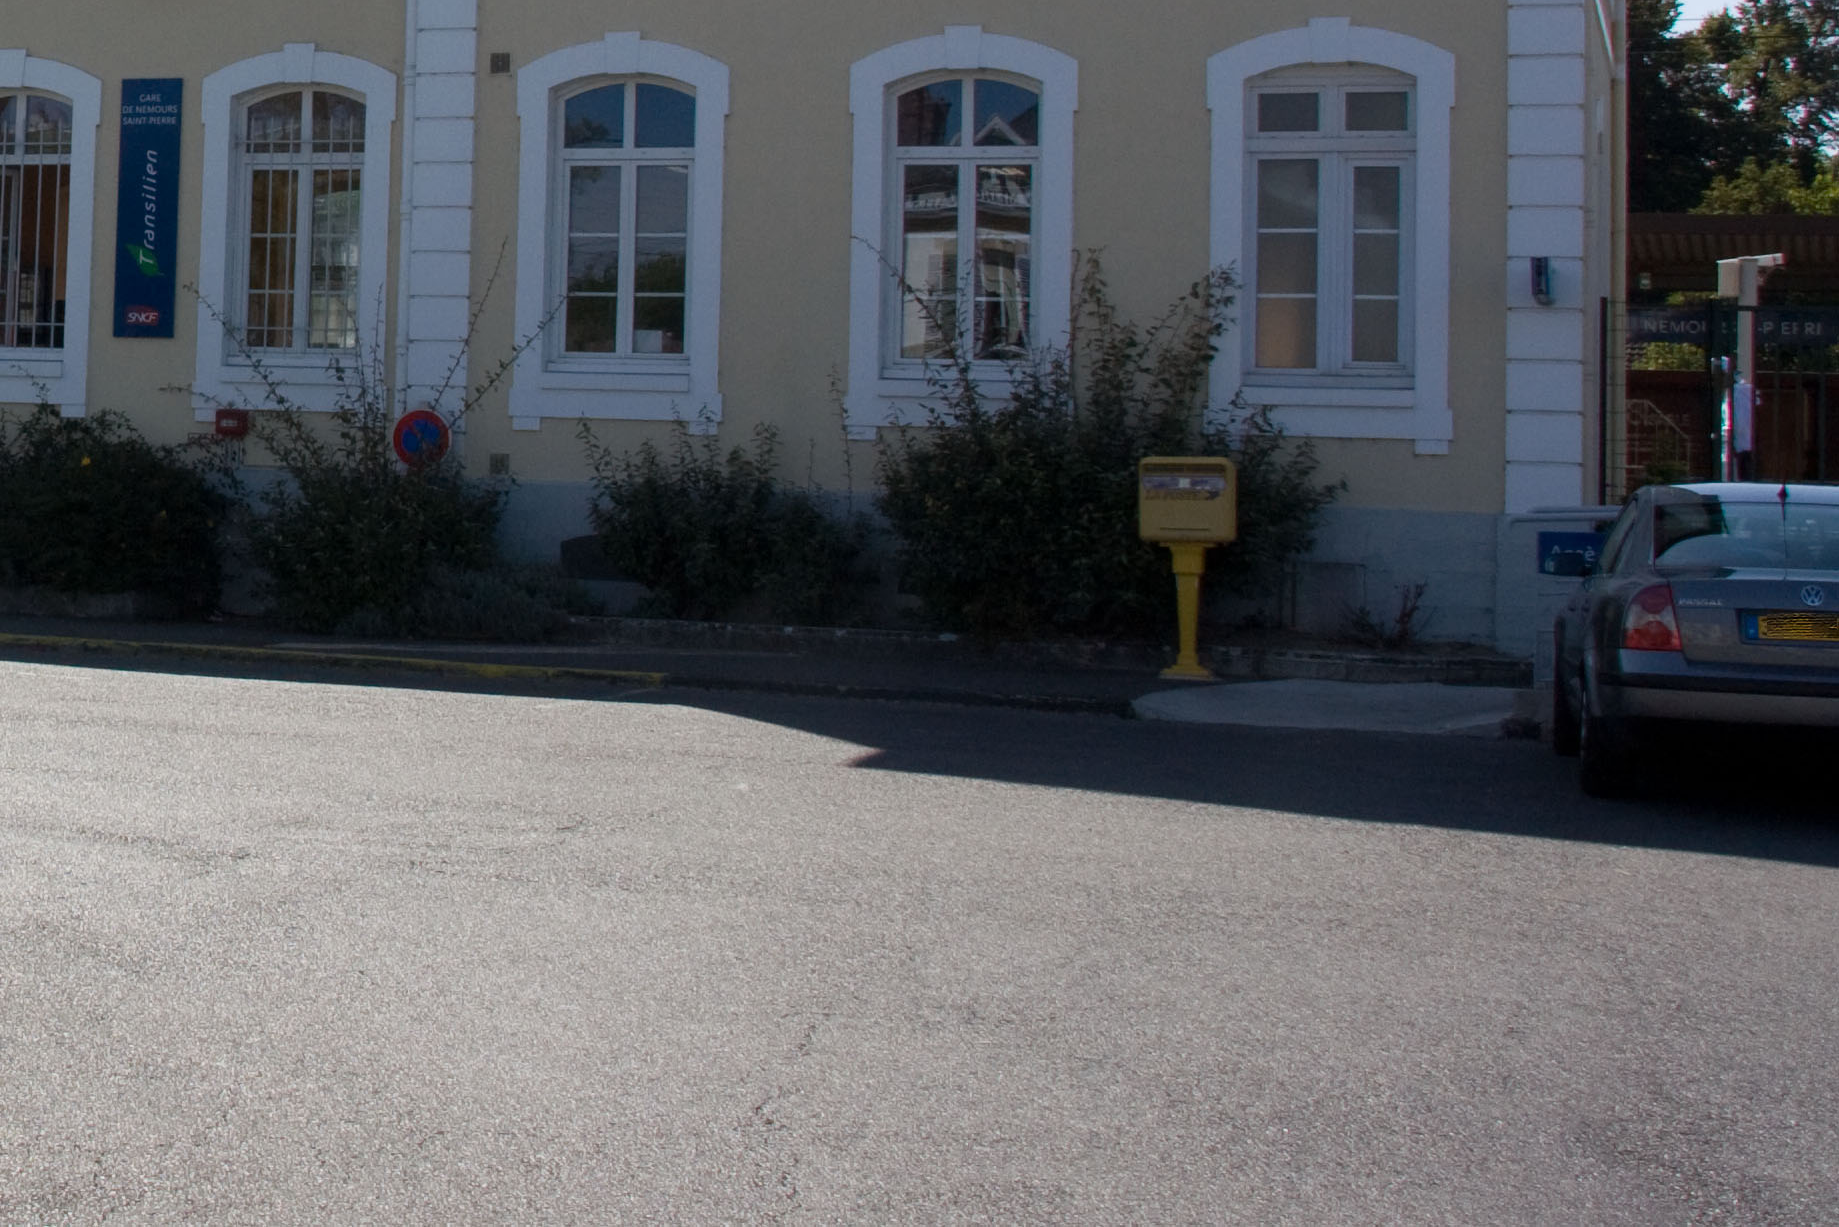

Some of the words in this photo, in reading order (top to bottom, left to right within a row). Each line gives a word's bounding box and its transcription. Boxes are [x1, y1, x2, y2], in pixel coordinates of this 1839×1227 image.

[139, 93, 161, 102] GARE
[122, 105, 134, 114] DE
[135, 104, 178, 114] NEMOURS
[139, 149, 158, 264] Transilien
[127, 311, 158, 323] SNCF
